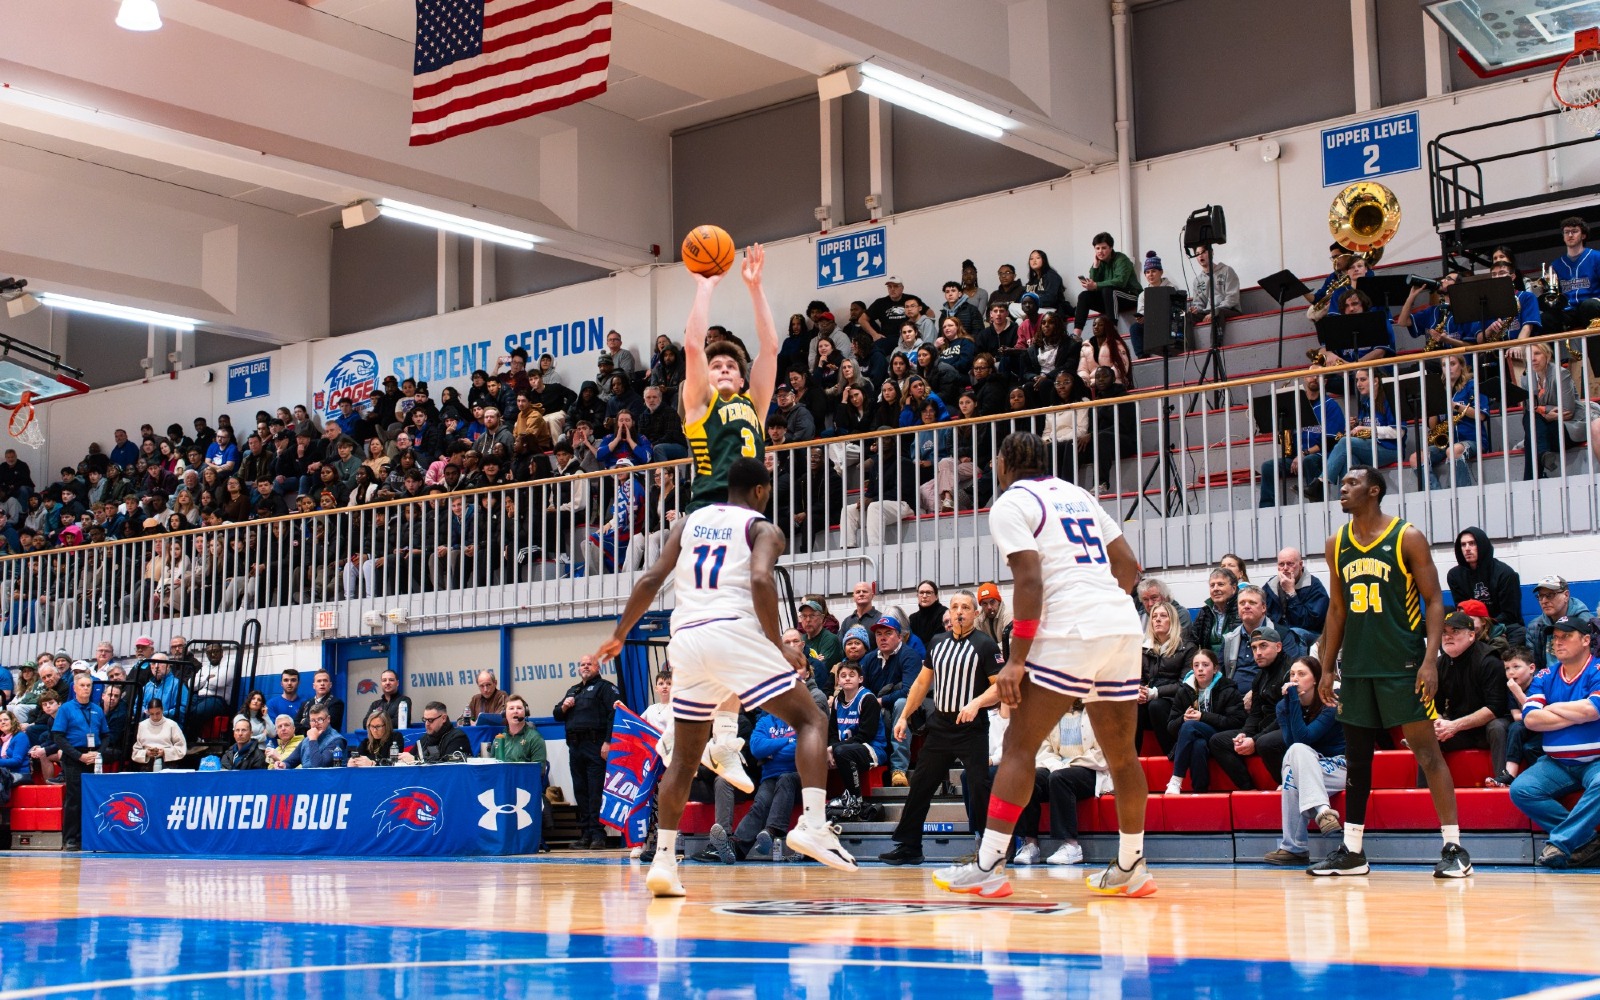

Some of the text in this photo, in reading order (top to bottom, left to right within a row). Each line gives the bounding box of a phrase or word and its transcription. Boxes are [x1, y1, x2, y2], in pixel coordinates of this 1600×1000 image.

[1326, 119, 1414, 149] UPPER LEVEL
[1363, 144, 1380, 175] 2
[820, 232, 883, 257] UPPER LEVEL
[832, 251, 869, 282] 1 2
[392, 316, 604, 388] STUDENT SECTION
[229, 361, 268, 379] UPPER LEVEL
[336, 373, 357, 390] THE
[244, 377, 252, 398] 1
[740, 426, 757, 459] 3
[693, 525, 733, 540] SPENCER
[1060, 517, 1108, 564] 55
[693, 544, 727, 589] 11
[1342, 557, 1392, 584] VERMONT
[1350, 582, 1383, 613] 34
[319, 612, 333, 628] EXIT
[923, 823, 946, 832] ROW 1
